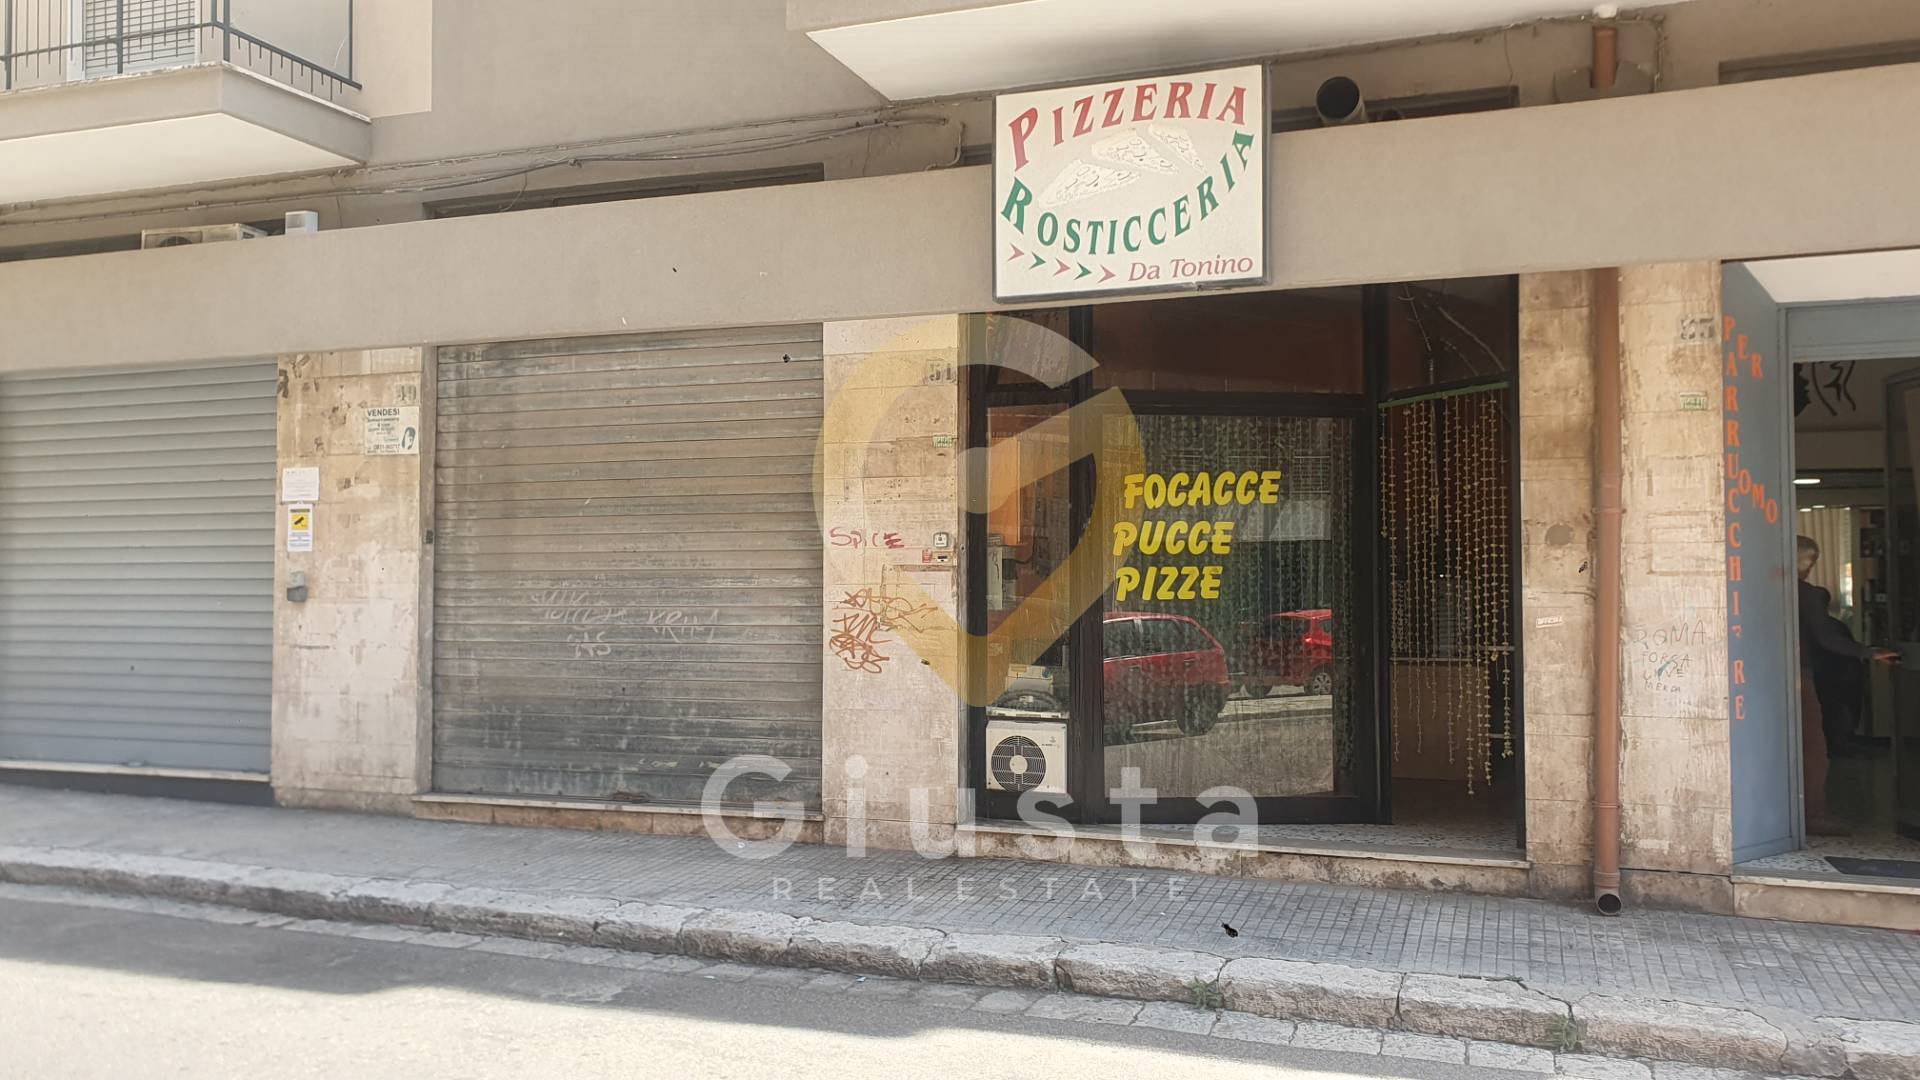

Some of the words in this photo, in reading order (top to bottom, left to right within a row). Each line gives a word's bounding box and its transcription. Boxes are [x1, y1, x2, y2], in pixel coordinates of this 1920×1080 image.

[1007, 82, 1247, 172] PIZZERIA
[1000, 130, 1255, 255] ROSTICCERIA
[1128, 262, 1161, 282] Da
[1170, 254, 1253, 278] Tonino
[367, 408, 400, 417] VENDESI
[1124, 470, 1281, 509] FOCACCE
[1722, 315, 1746, 721] PARRUCCHIRE
[1113, 520, 1235, 556] PUCCE
[1116, 566, 1224, 602] PIZZE
[1633, 619, 1706, 650] ROMA
